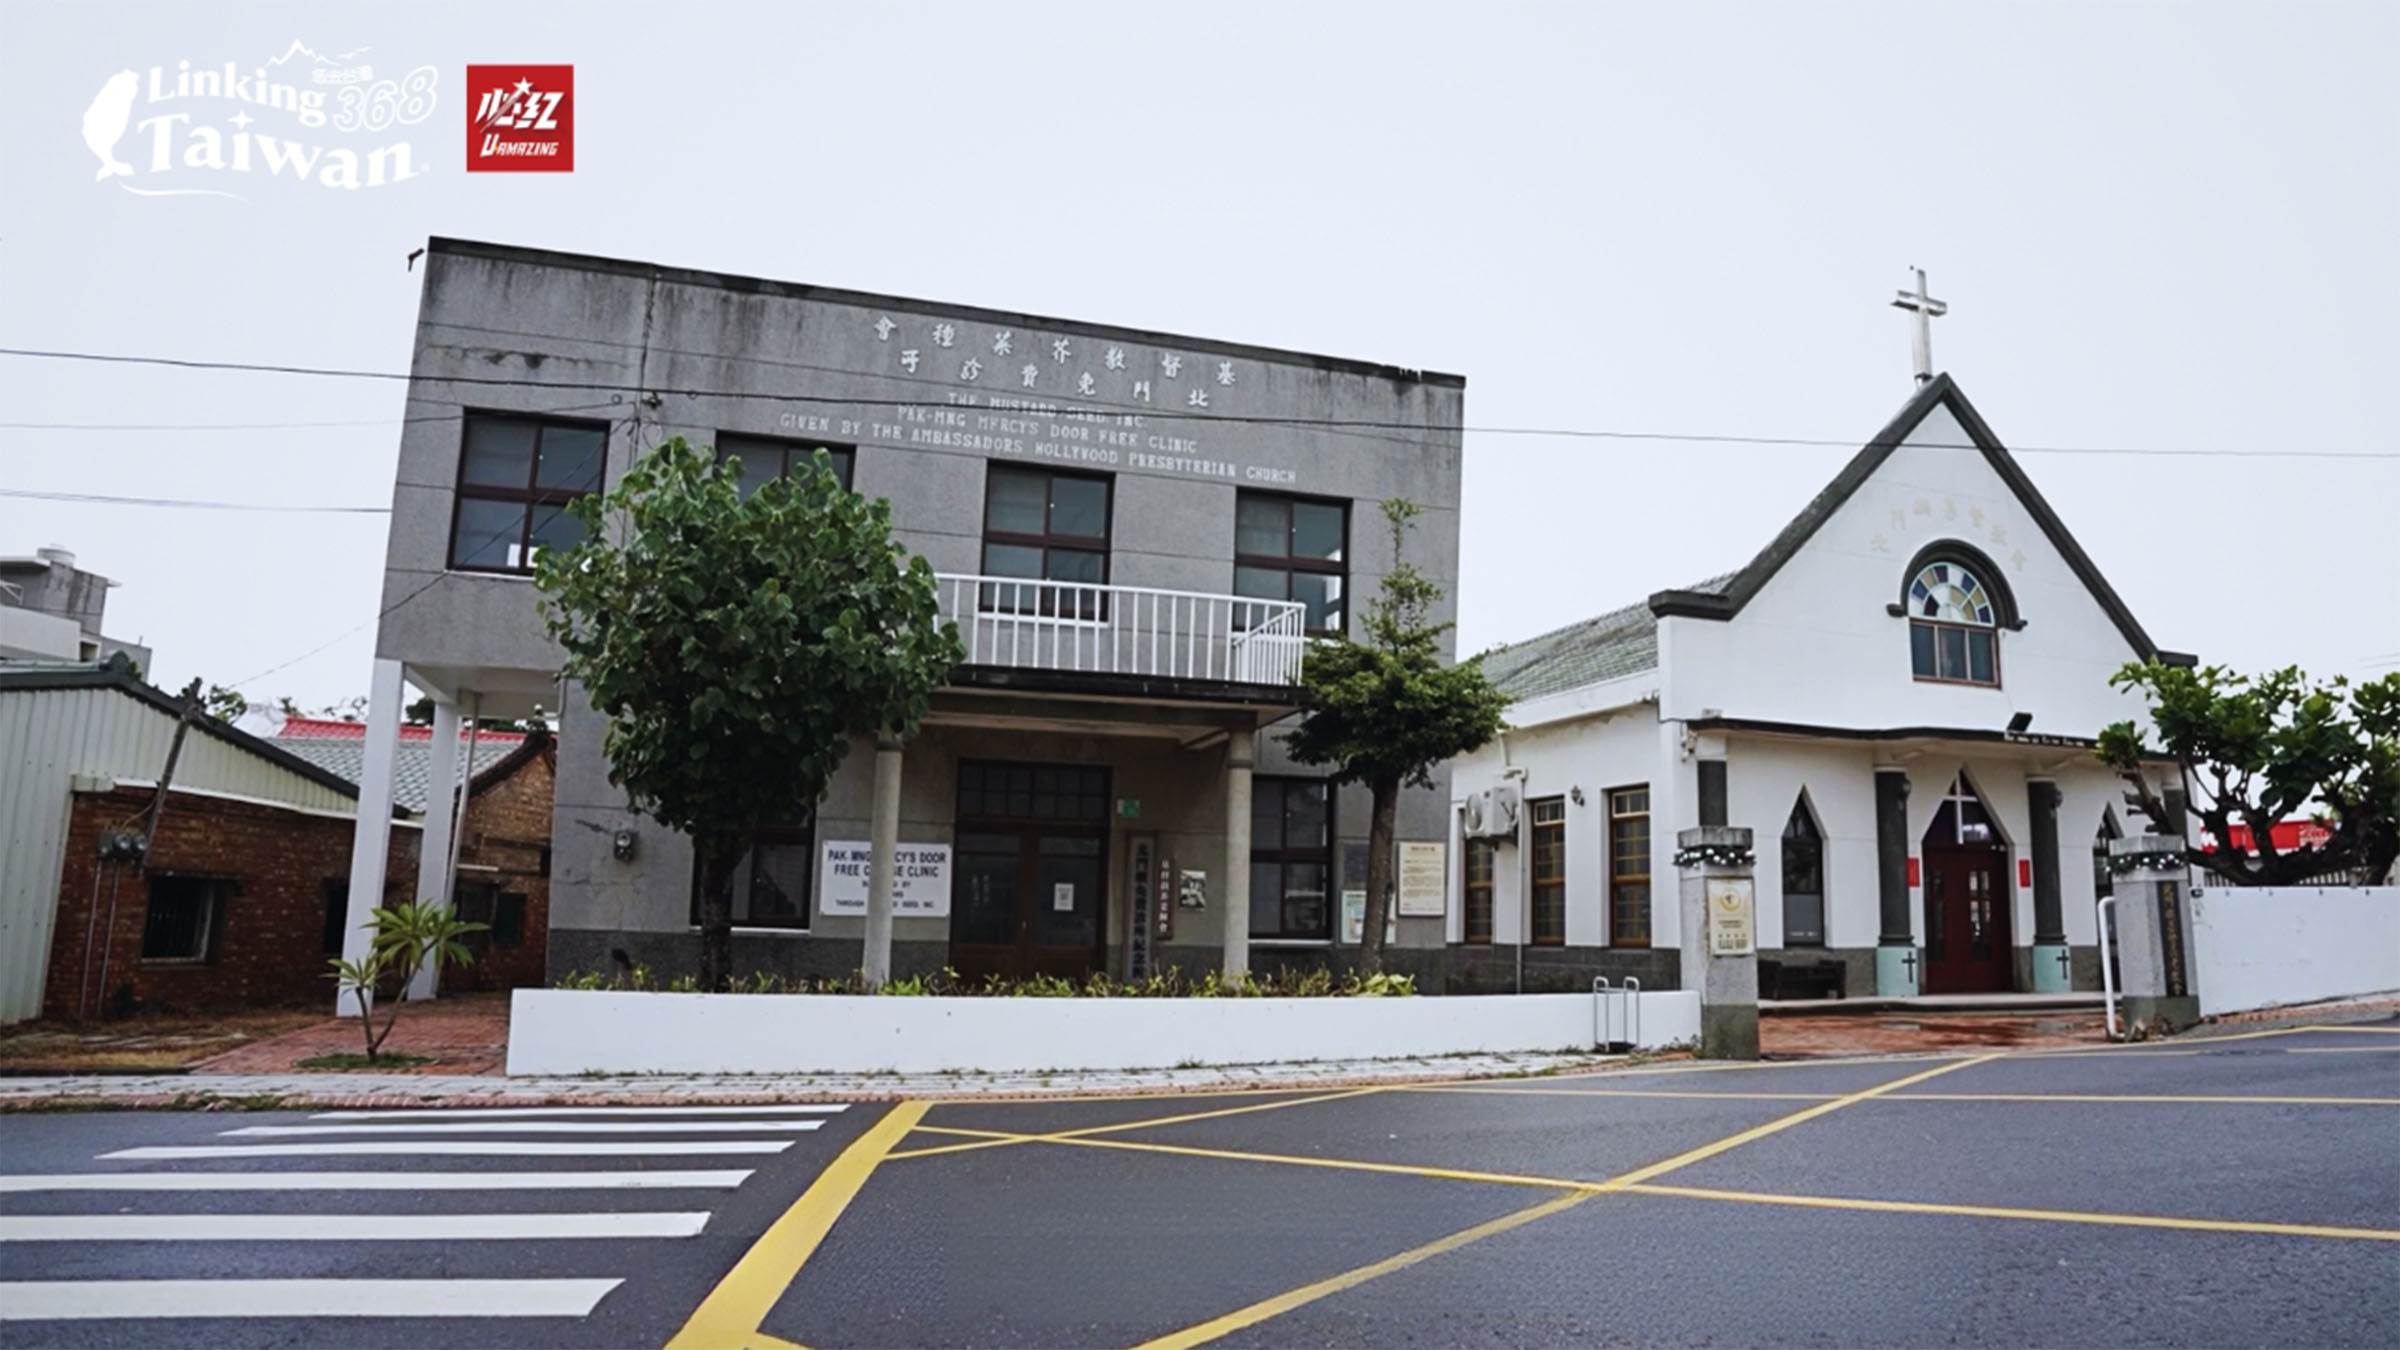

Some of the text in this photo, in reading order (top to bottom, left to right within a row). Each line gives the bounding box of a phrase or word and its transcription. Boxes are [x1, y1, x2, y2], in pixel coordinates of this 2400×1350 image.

[949, 391, 978, 406] THE
[1050, 424, 1089, 441] DOOR
[1099, 431, 1138, 446] FREE
[1149, 435, 1198, 453] CLINIC
[780, 412, 1297, 483] GIVEN BY THE AMBASSADORS HOLLYWOOD PRESBYTERIAN CHURCH
[919, 852, 947, 864] DOOR
[834, 863, 860, 876] FREE
[907, 865, 939, 878] CLINIC
